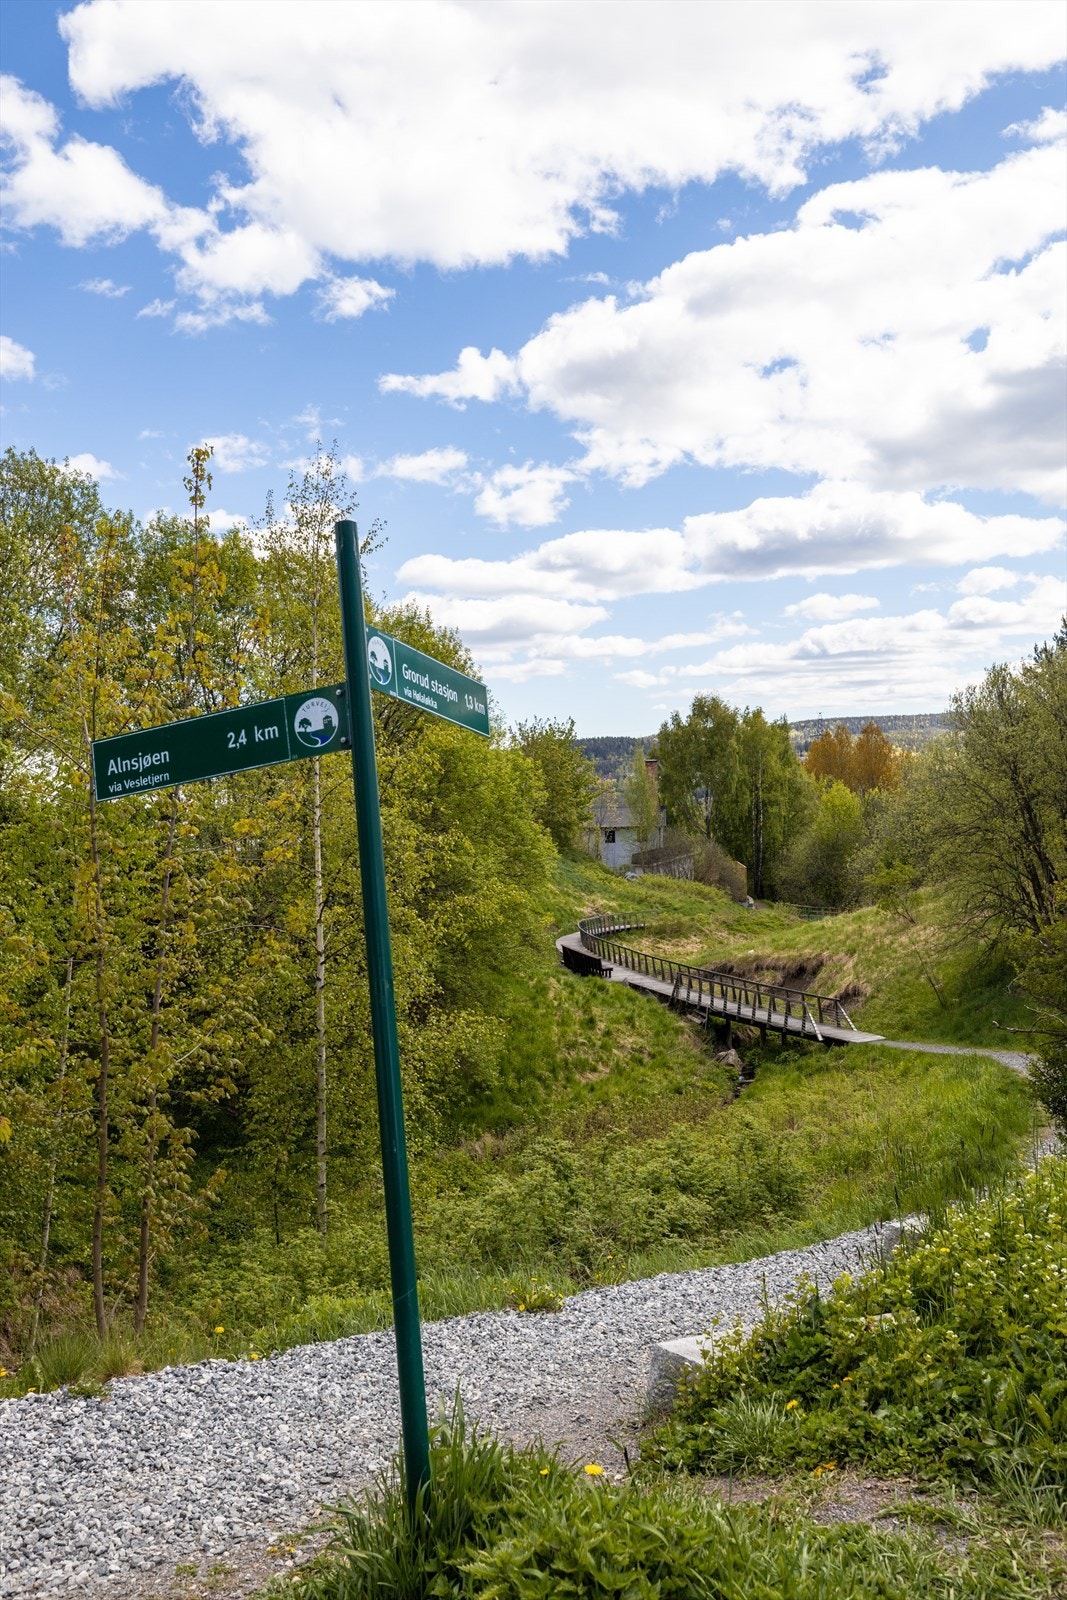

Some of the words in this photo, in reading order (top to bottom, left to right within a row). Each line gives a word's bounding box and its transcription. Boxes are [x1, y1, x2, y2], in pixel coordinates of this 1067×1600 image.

[402, 663, 430, 690] Grorud
[431, 680, 459, 703] stasjon
[474, 697, 486, 716] km
[403, 686, 413, 699] via
[107, 750, 170, 776] Alnsjøen
[227, 728, 248, 750] 2,4
[254, 725, 280, 743] km
[108, 781, 122, 793] via
[124, 772, 170, 790] Vesletjern
